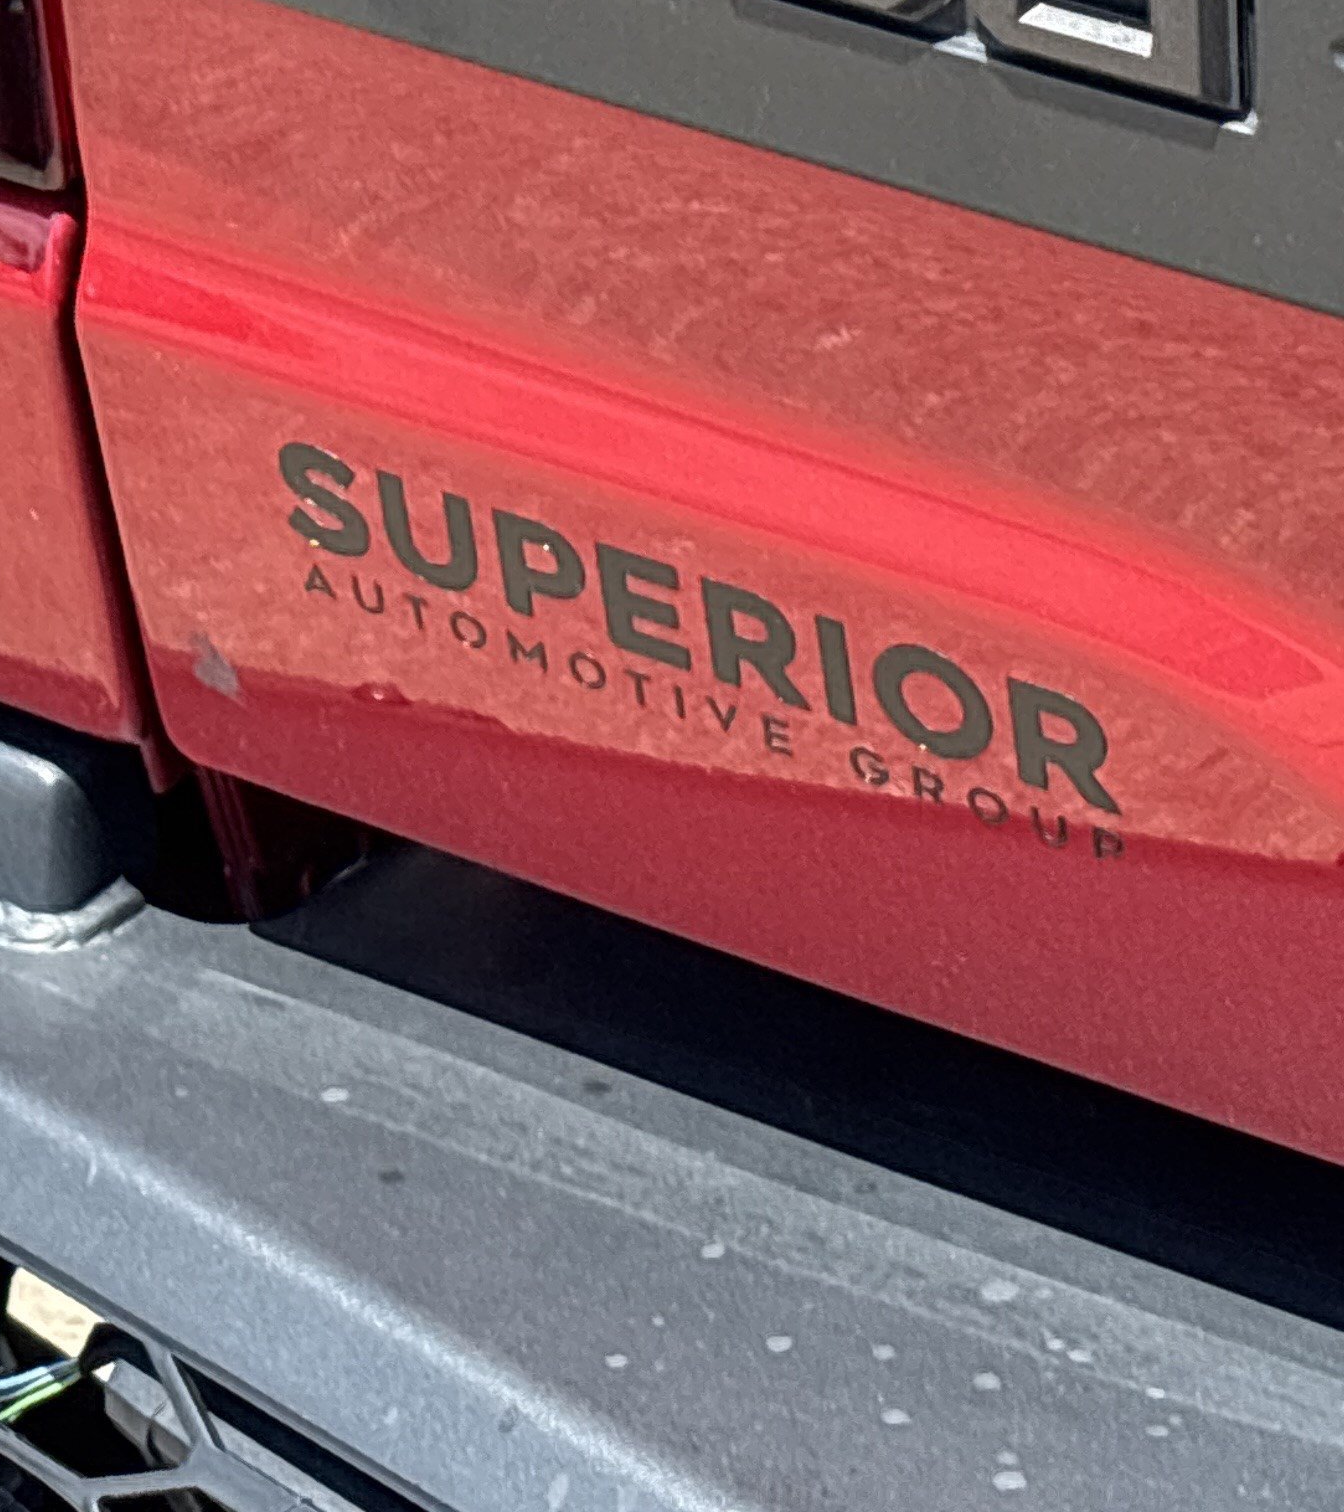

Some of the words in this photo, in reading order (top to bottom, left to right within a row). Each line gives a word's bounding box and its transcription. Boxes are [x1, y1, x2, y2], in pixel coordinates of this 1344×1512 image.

[277, 441, 1124, 816] SUPERIOR
[302, 563, 794, 756] AUTOMOTIVE
[849, 744, 1125, 861] GROUP
